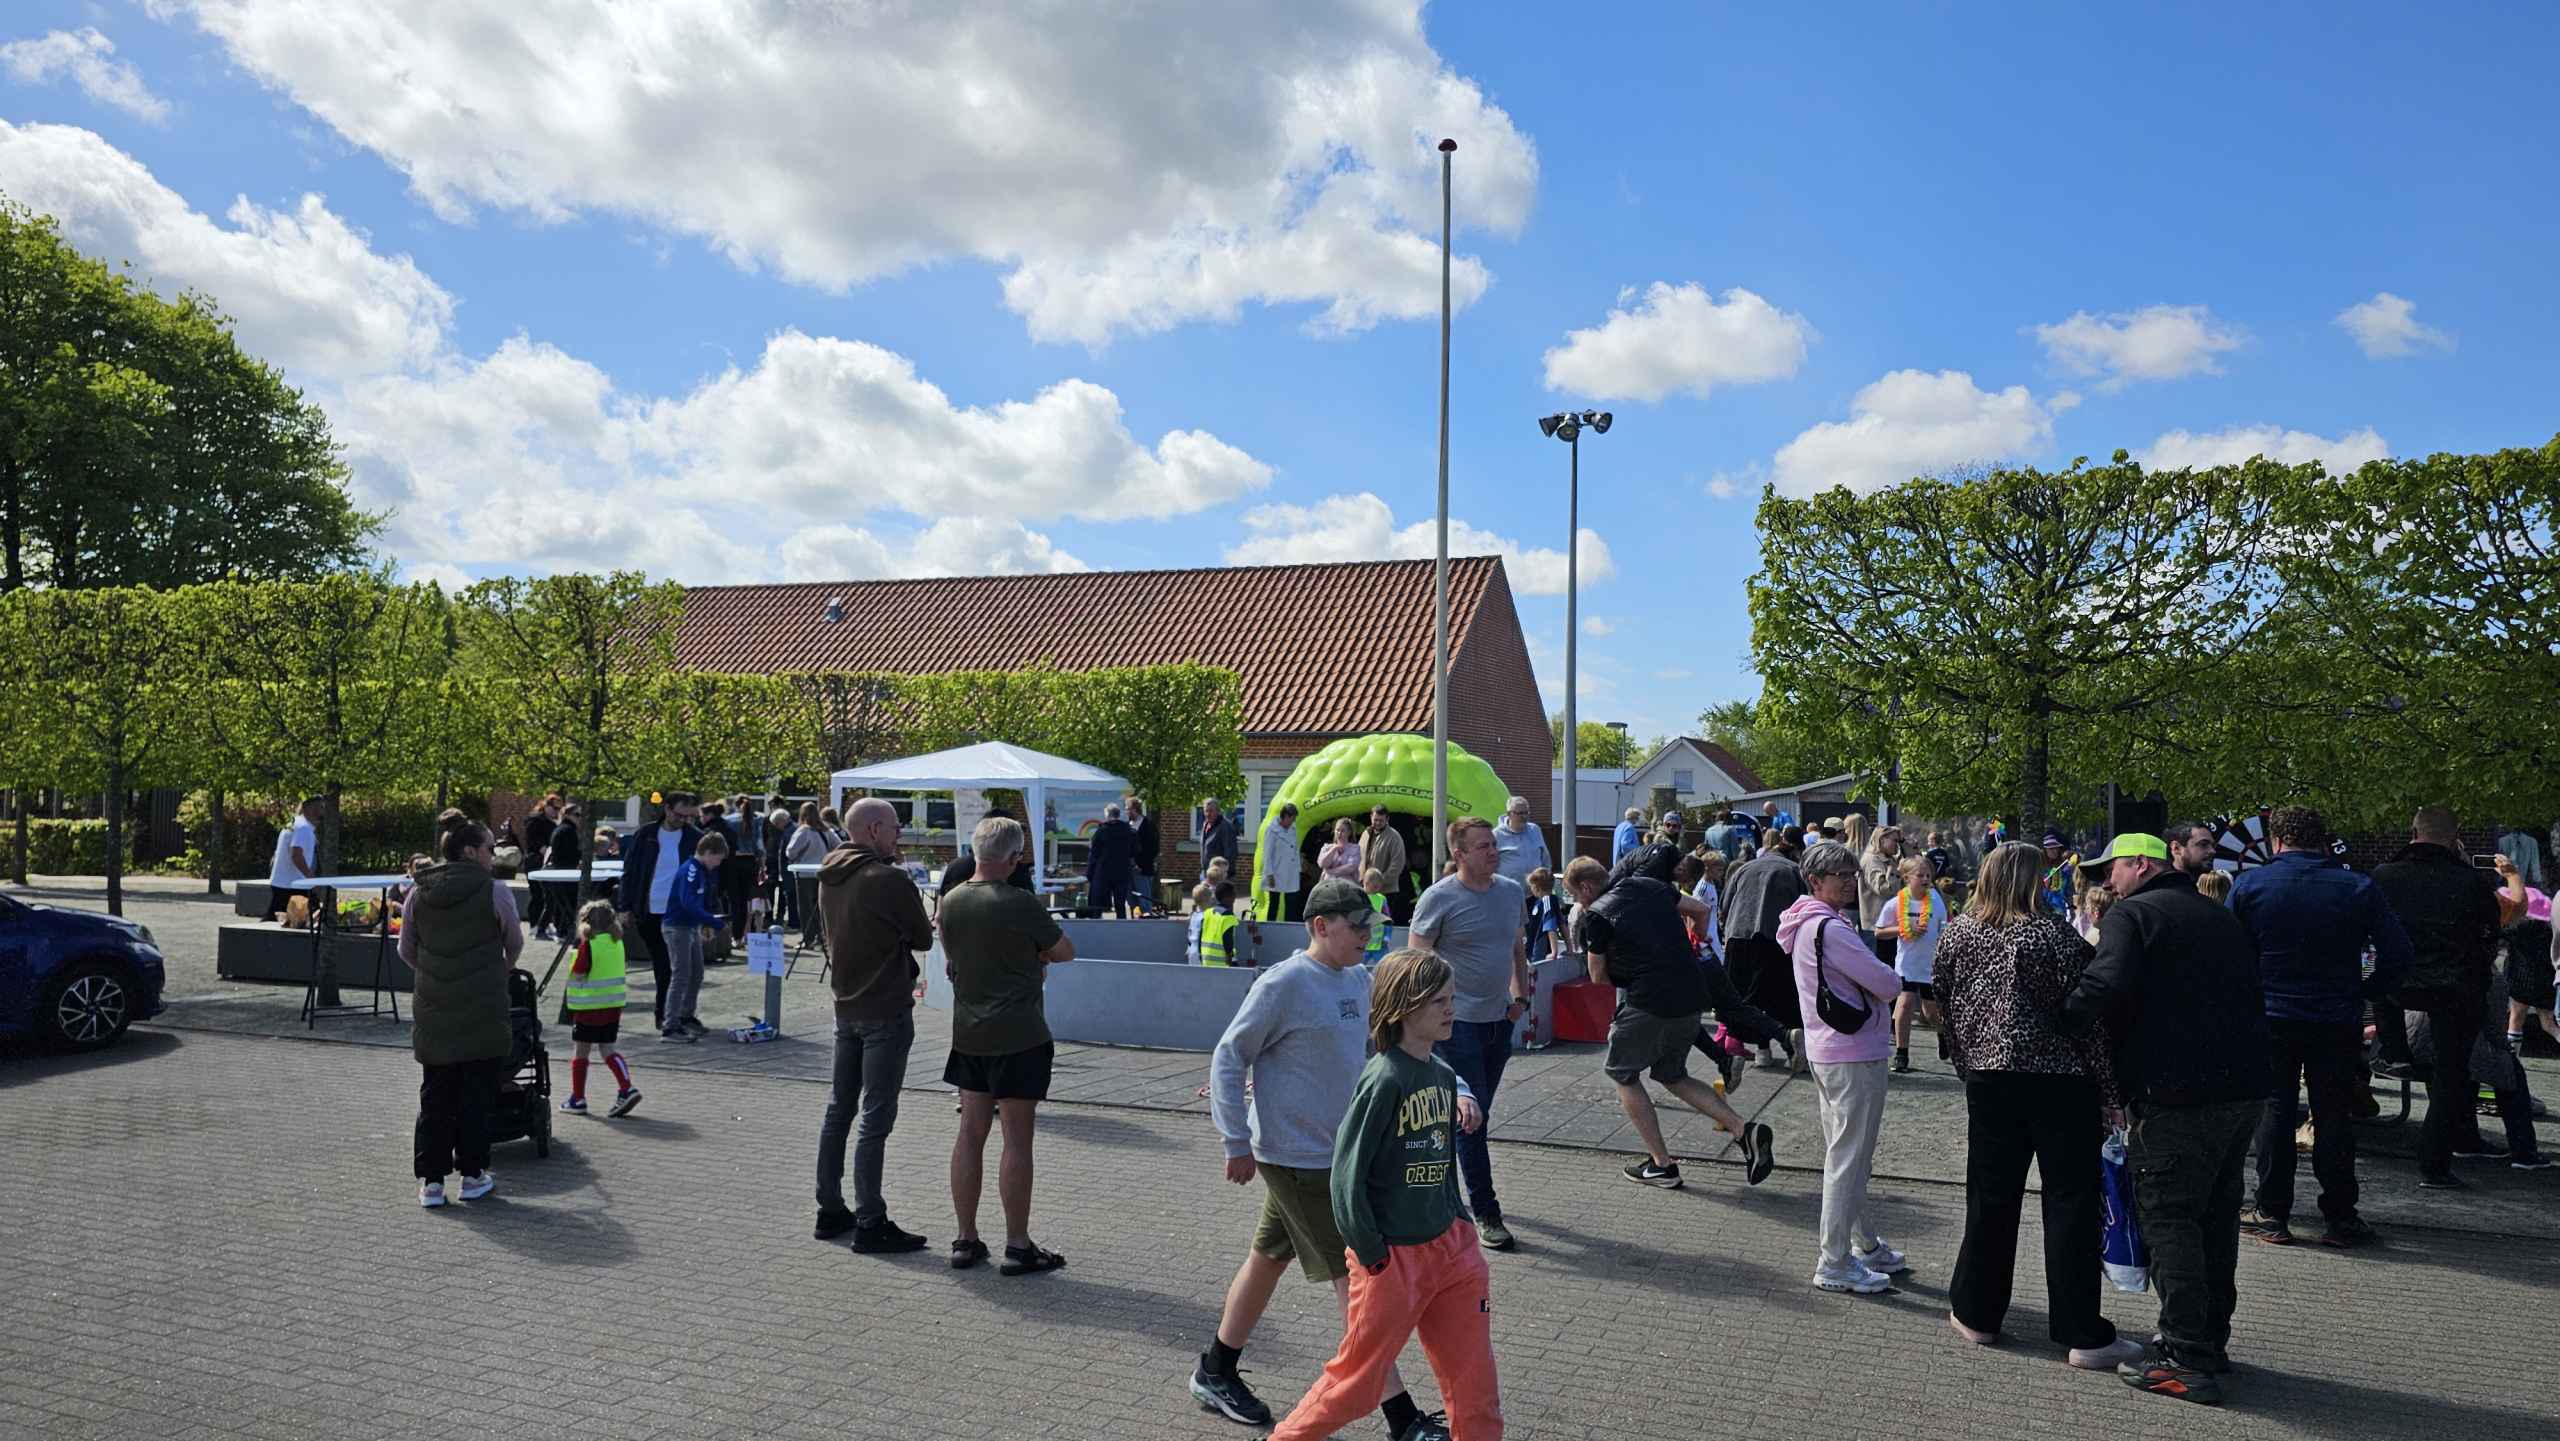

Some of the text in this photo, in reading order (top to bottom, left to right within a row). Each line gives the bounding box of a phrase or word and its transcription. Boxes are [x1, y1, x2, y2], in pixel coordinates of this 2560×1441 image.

[1377, 785, 1413, 796] SPACE
[1414, 789, 1471, 812] UNRSE
[2331, 838, 2347, 855] 13
[1935, 860, 1944, 874] 7
